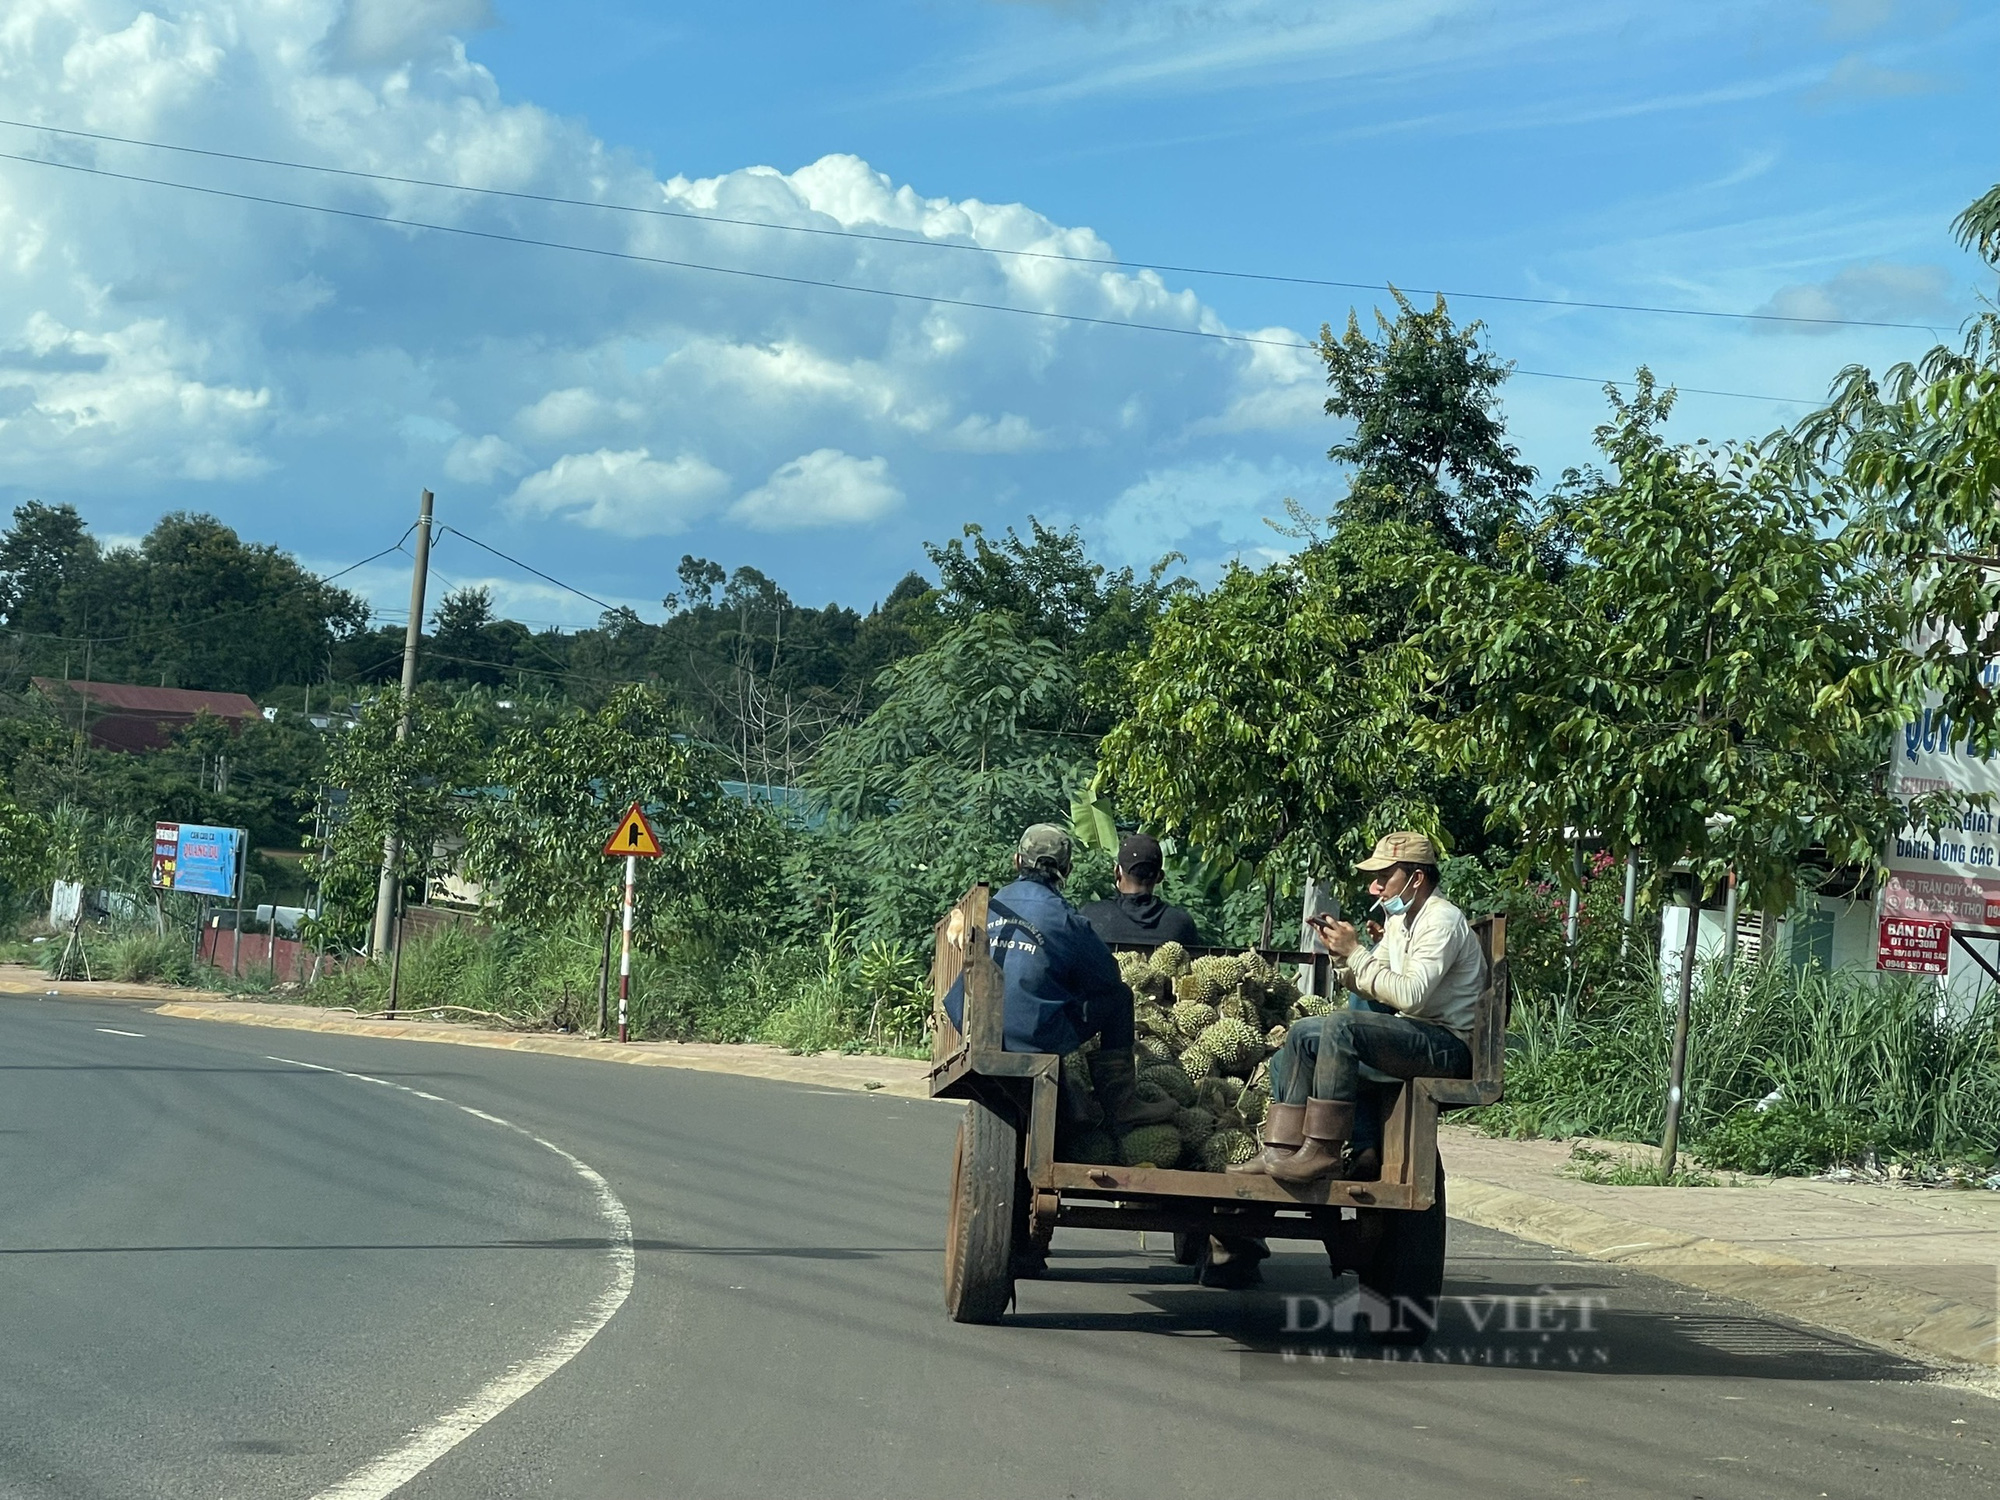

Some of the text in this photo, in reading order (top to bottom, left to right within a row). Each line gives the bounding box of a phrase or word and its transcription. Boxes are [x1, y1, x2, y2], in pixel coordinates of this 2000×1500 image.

[1933, 839, 1966, 863] BÓNG
[1970, 843, 1994, 866] CÁC
[1888, 922, 1914, 937] BÁN
[1018, 941, 1036, 955] TRỊ
[1907, 961, 1923, 970] 357
